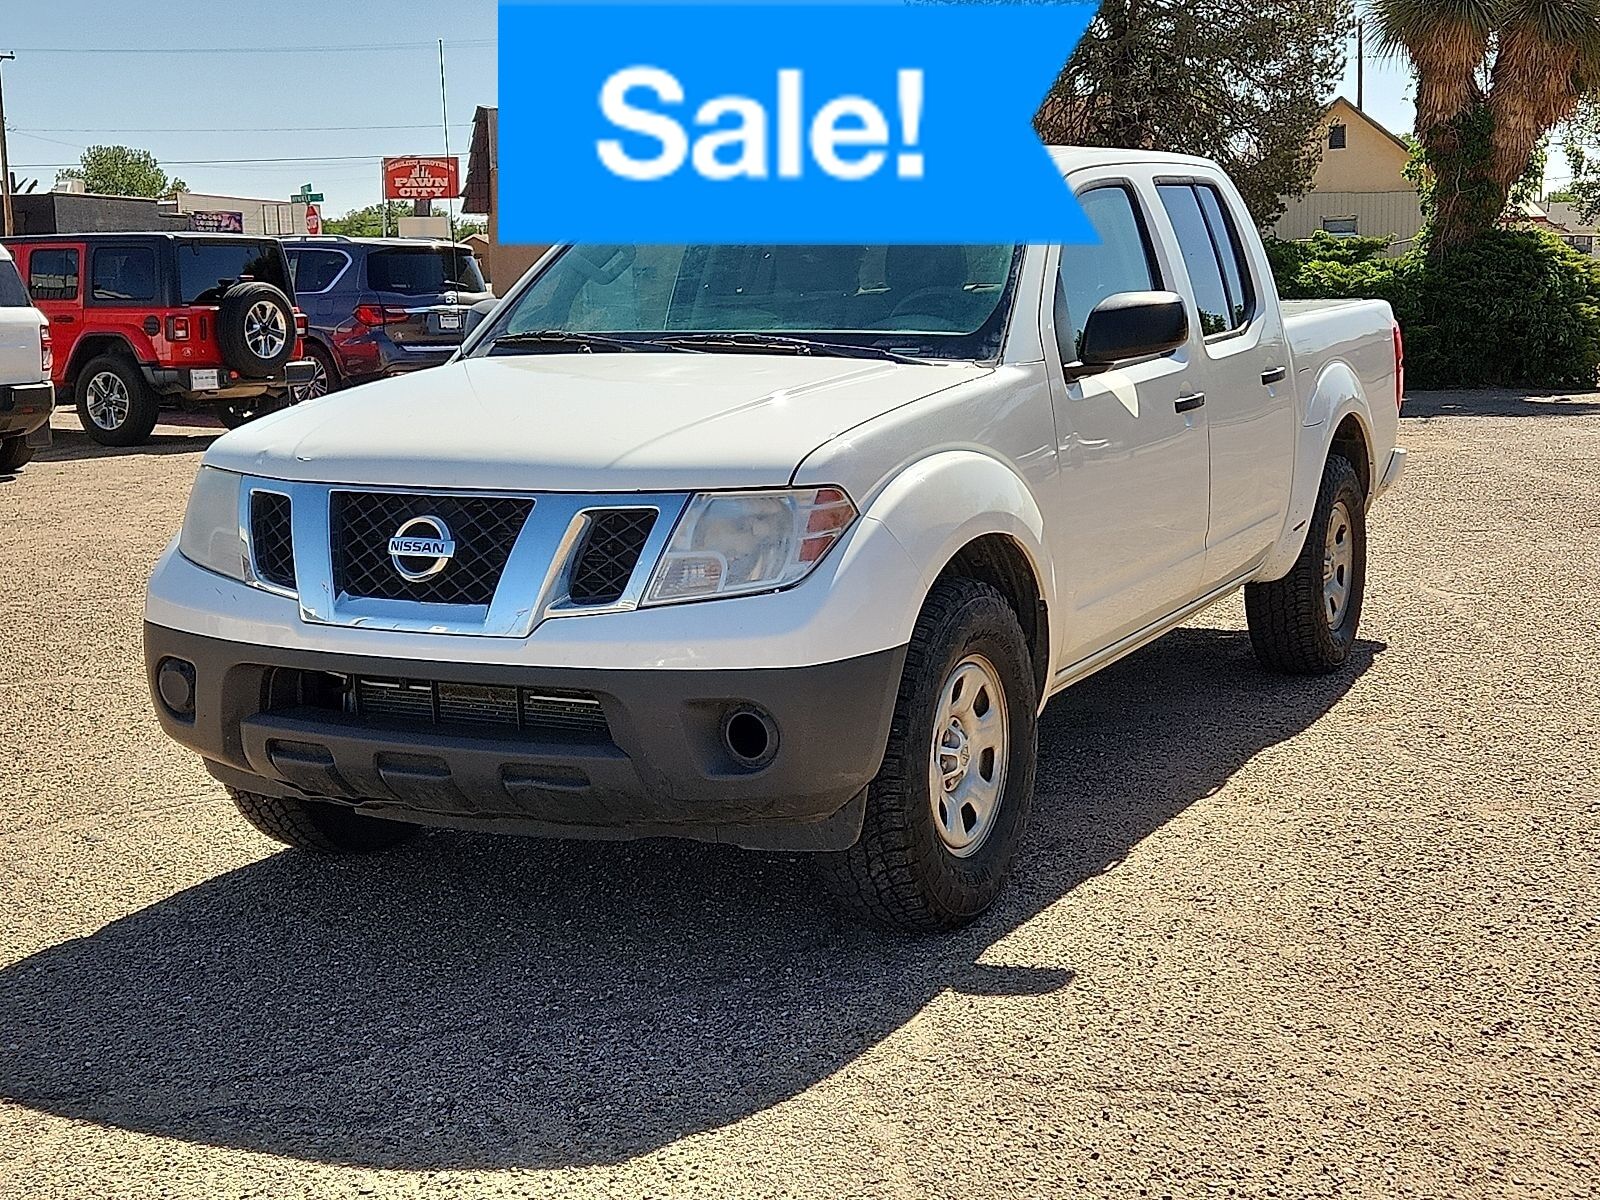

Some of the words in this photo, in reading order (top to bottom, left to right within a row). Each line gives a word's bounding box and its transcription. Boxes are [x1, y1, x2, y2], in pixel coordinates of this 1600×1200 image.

[394, 177, 448, 187] PAWN
[398, 187, 445, 197] CITY
[306, 214, 318, 229] STOP
[390, 540, 445, 554] NISSAN
